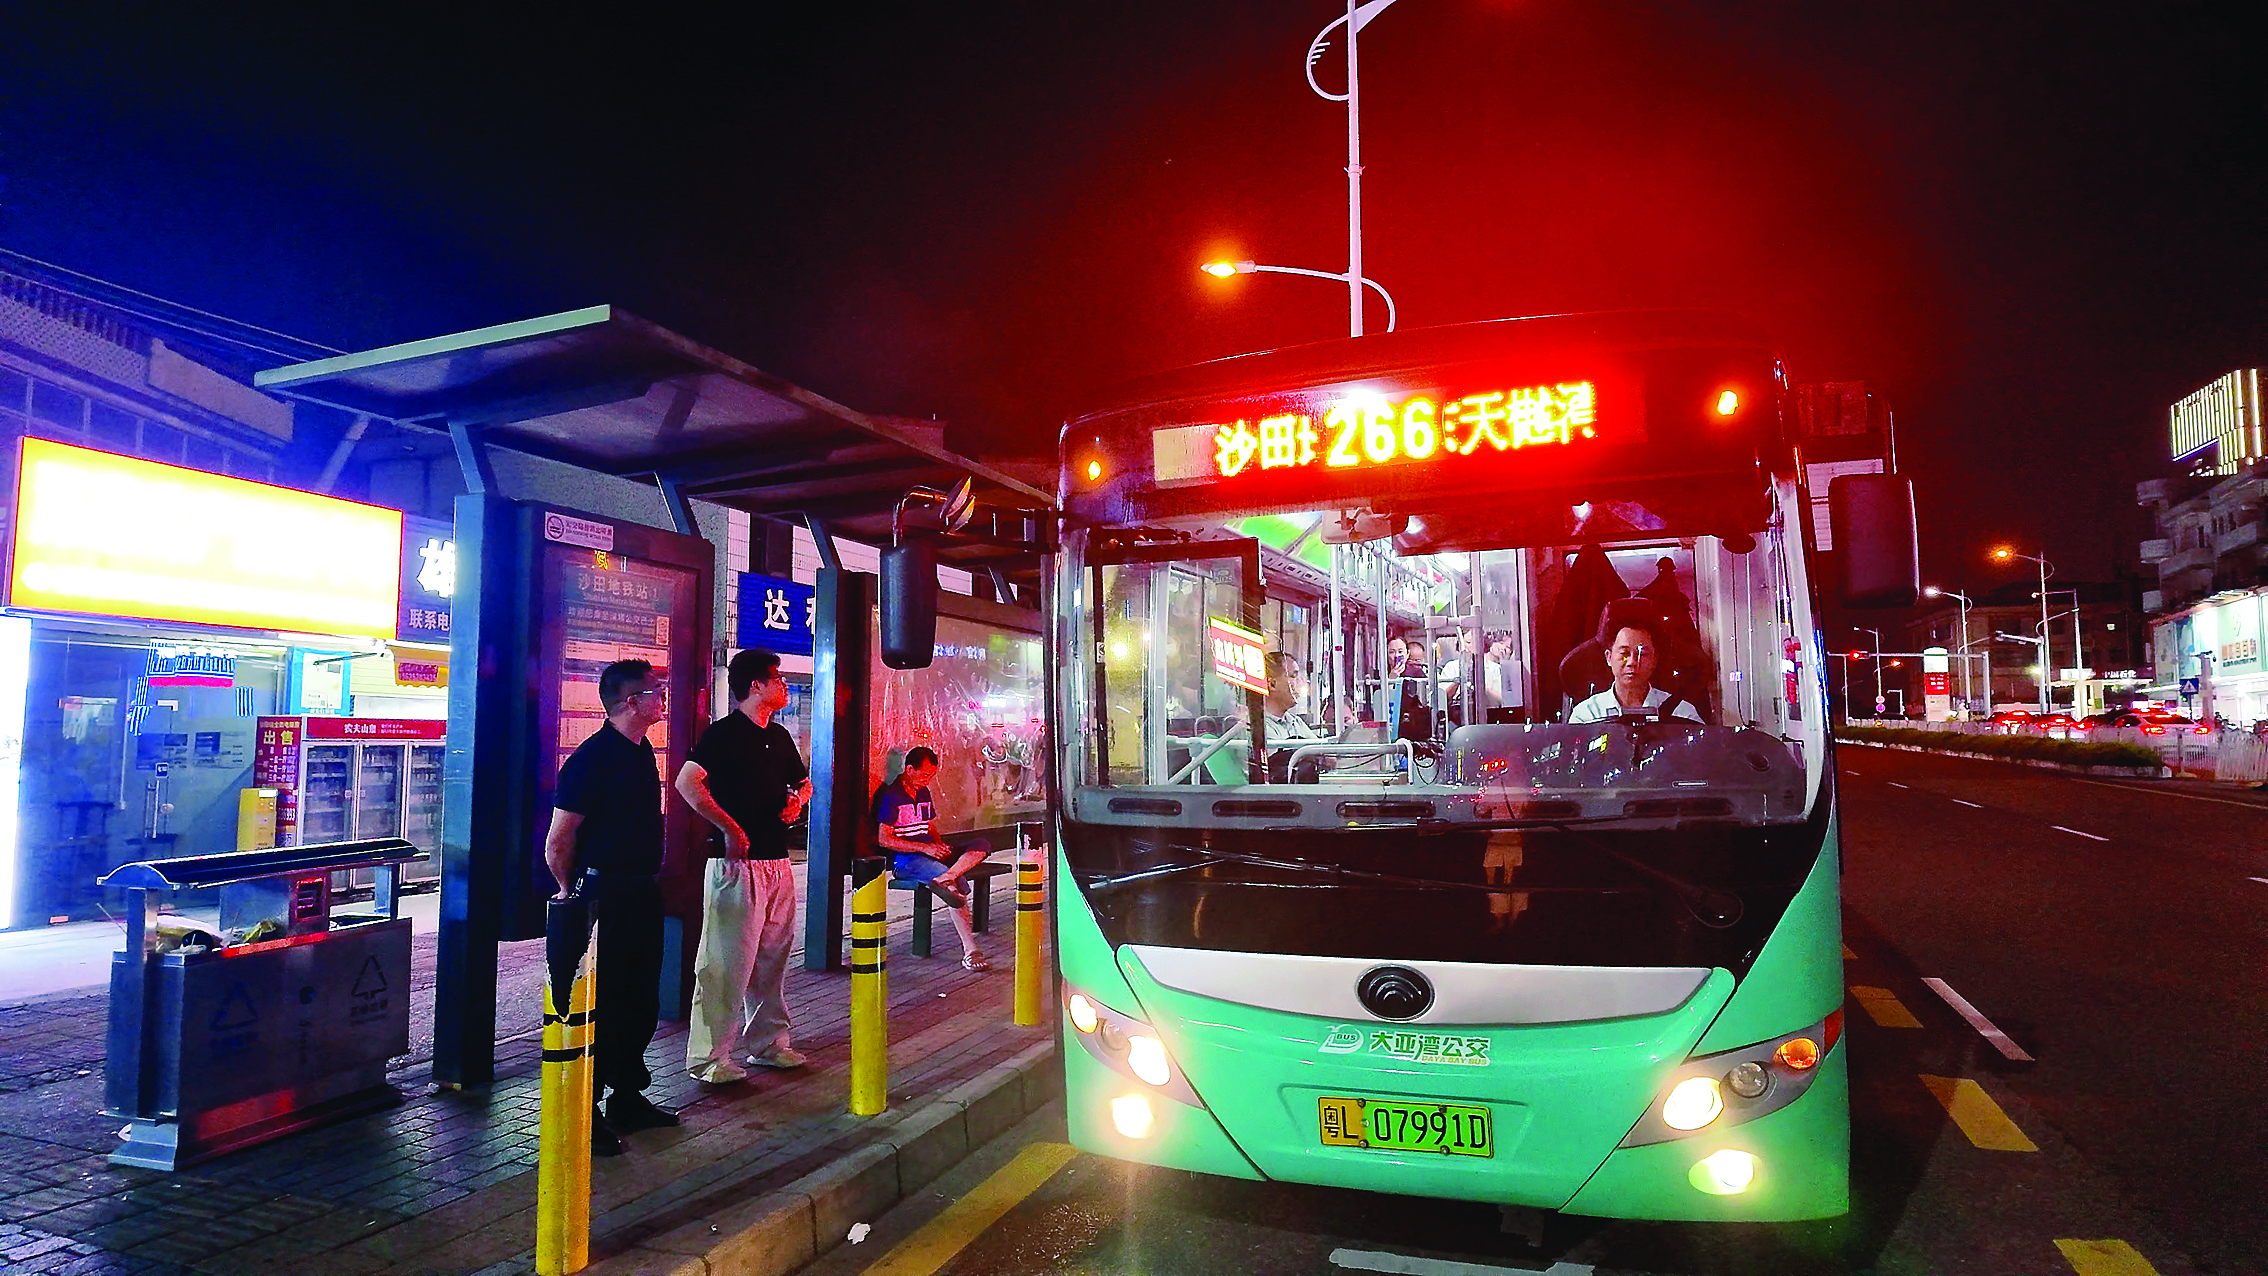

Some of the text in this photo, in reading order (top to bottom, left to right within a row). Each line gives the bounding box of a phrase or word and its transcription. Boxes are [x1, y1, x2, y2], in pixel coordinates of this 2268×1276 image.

[1325, 398, 1435, 467] 266
[578, 572, 649, 601] 沙田地铁站
[409, 608, 450, 631] 联系电
[263, 729, 294, 746] 出售
[1336, 1033, 1357, 1041] BUS
[1370, 1031, 1490, 1060] 大亚湾公交
